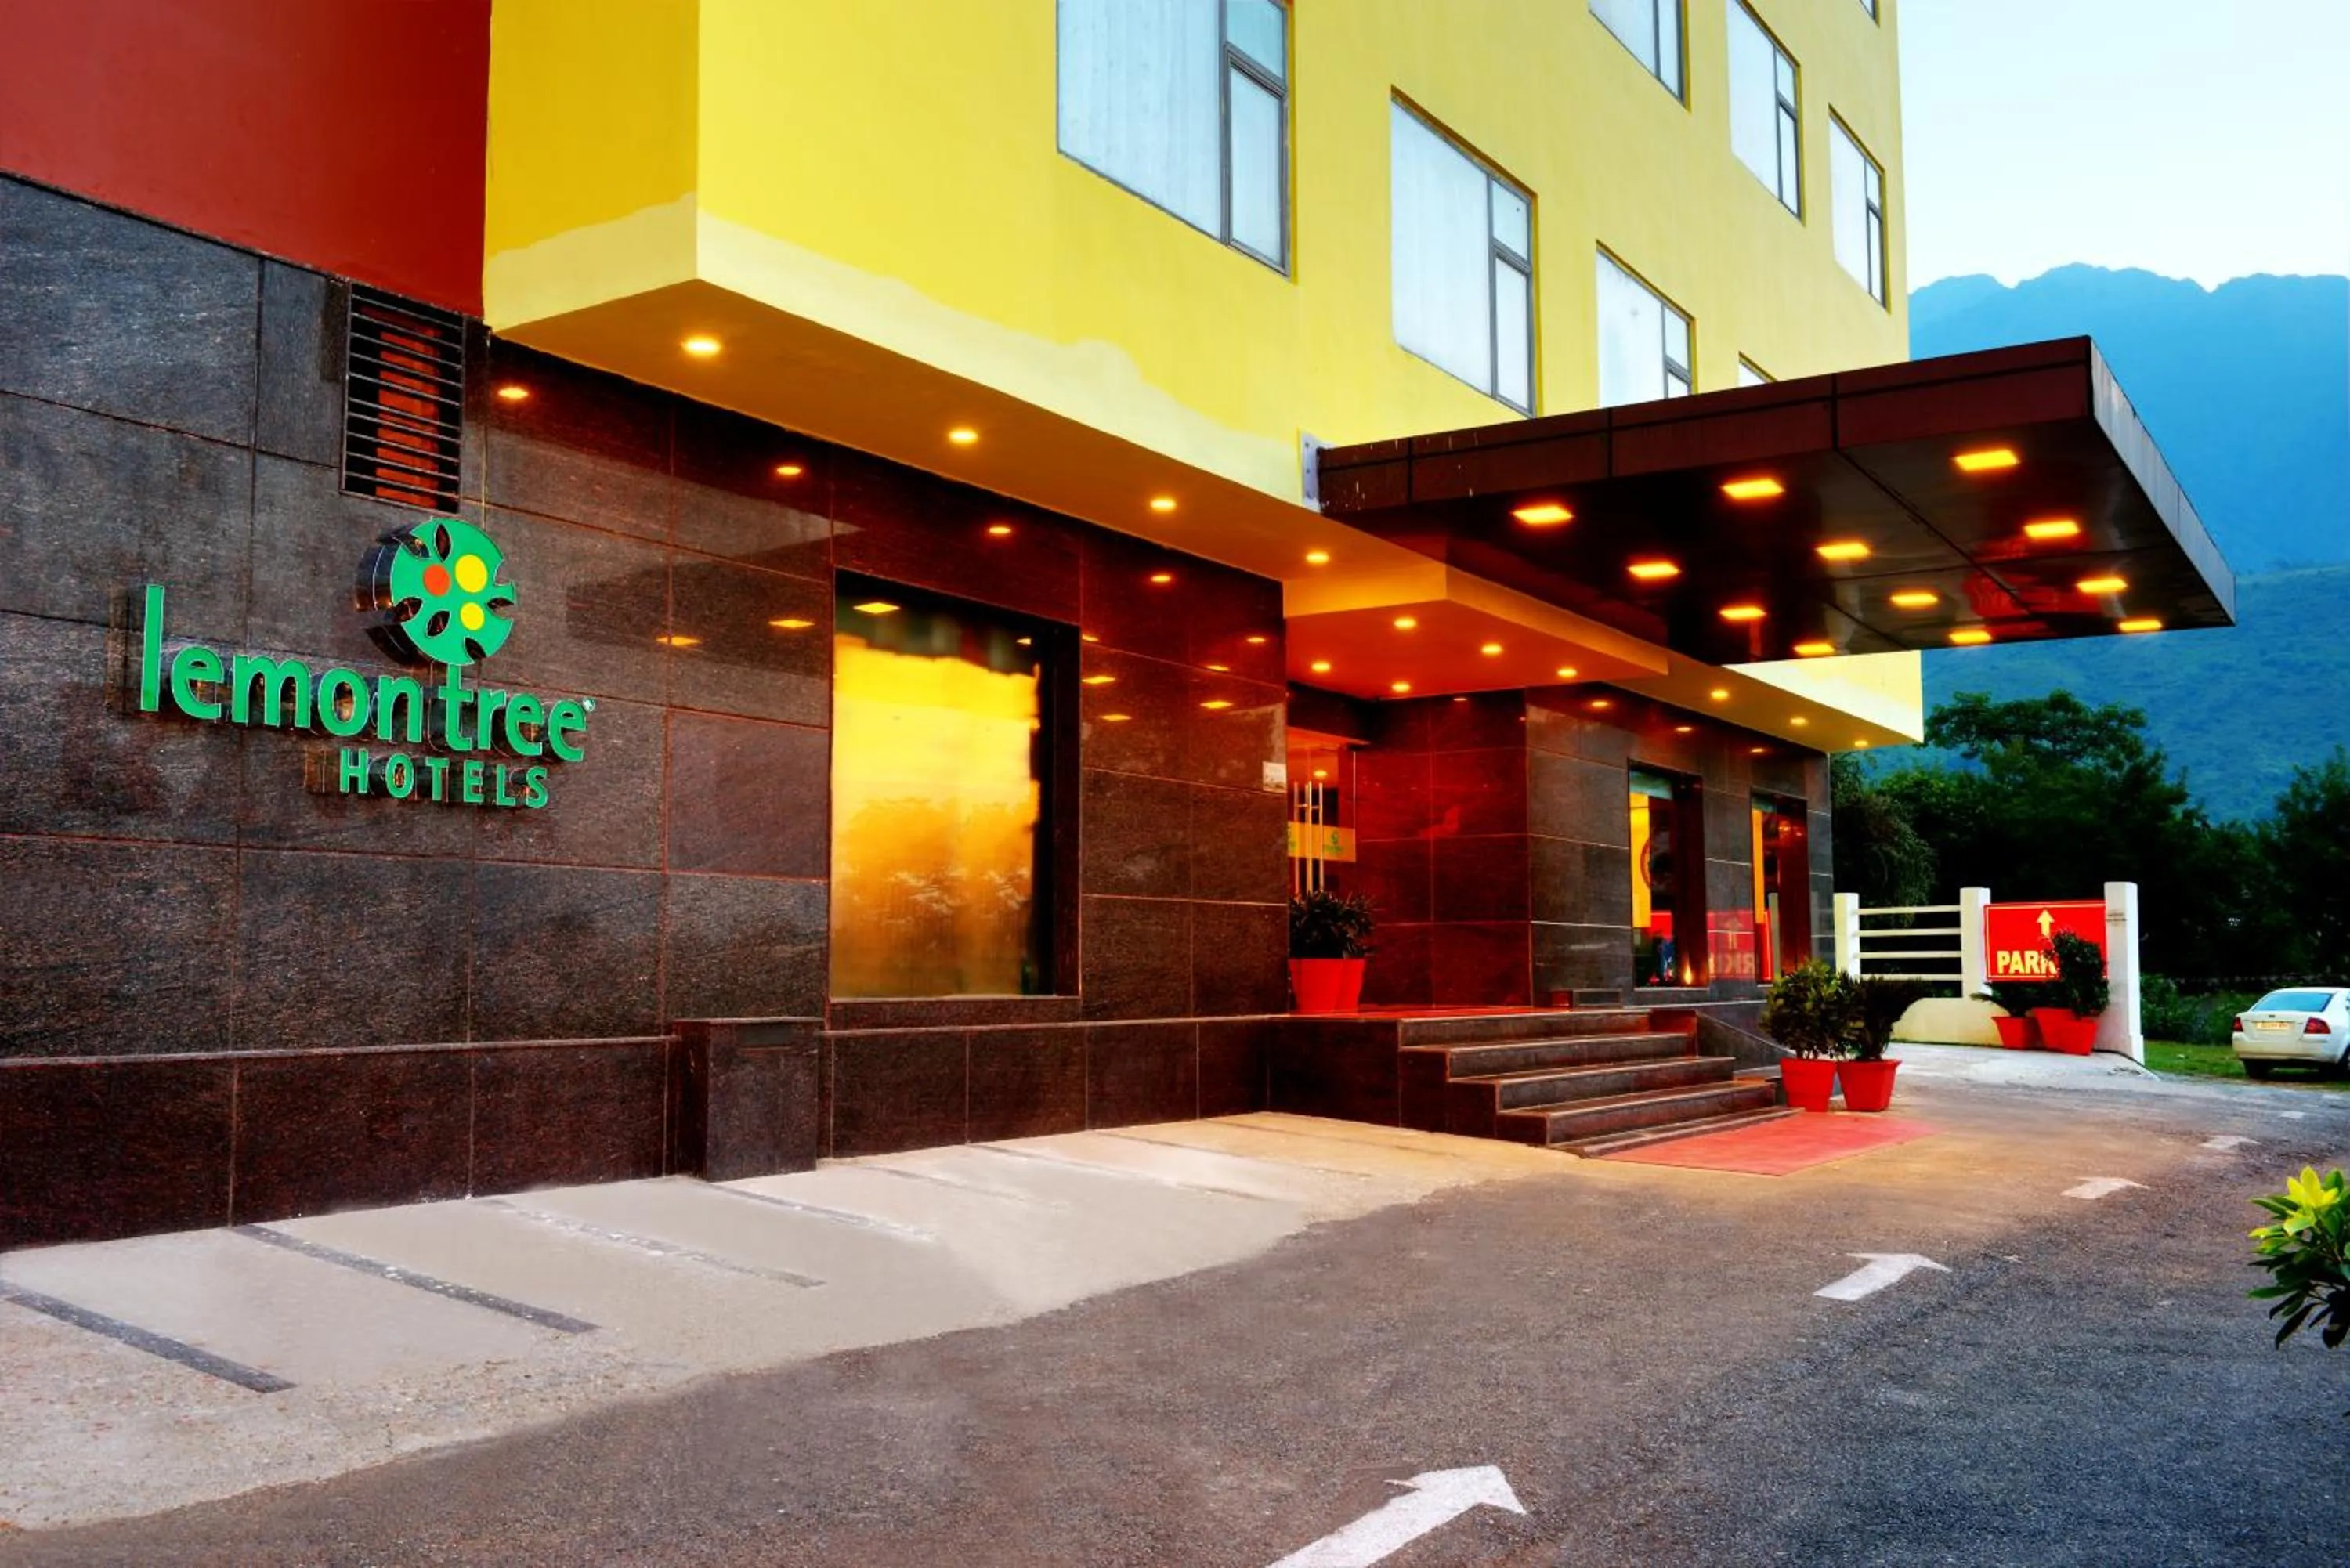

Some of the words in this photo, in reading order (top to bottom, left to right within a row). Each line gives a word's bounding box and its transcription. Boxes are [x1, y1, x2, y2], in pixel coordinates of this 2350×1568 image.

[140, 584, 424, 743] lemon
[339, 747, 548, 809] HOTELS
[1997, 949, 2058, 974] PARK
